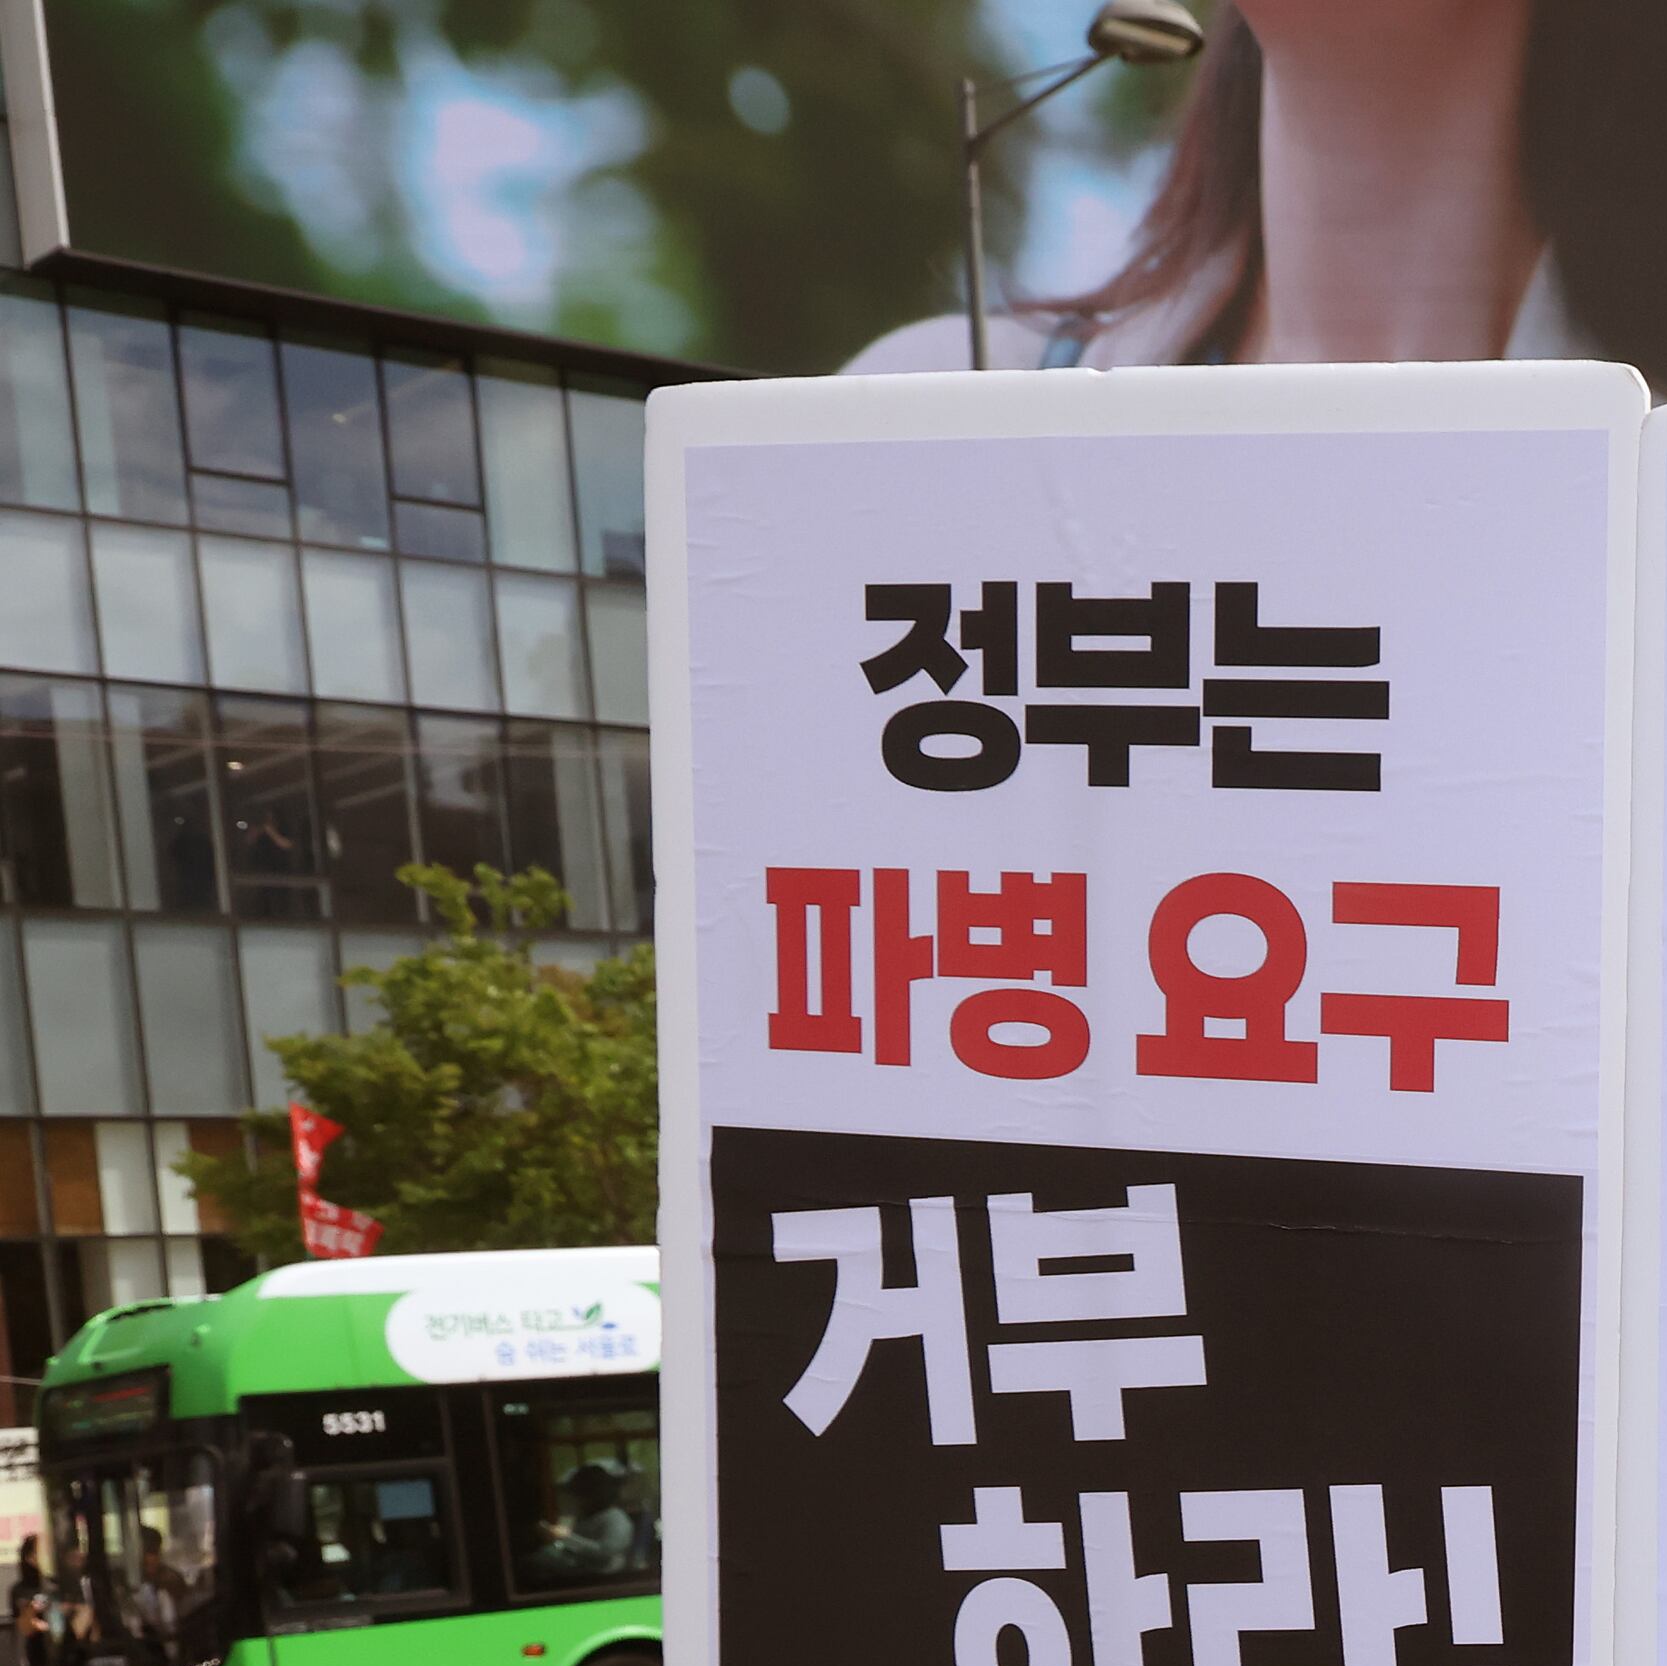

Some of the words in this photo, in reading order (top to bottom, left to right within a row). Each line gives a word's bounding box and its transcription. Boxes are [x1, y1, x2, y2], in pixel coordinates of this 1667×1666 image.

[859, 580, 1390, 792] 정부는
[765, 867, 1090, 1080] 파병
[1136, 872, 1509, 1092] 요구
[772, 1183, 1207, 1445] 거부
